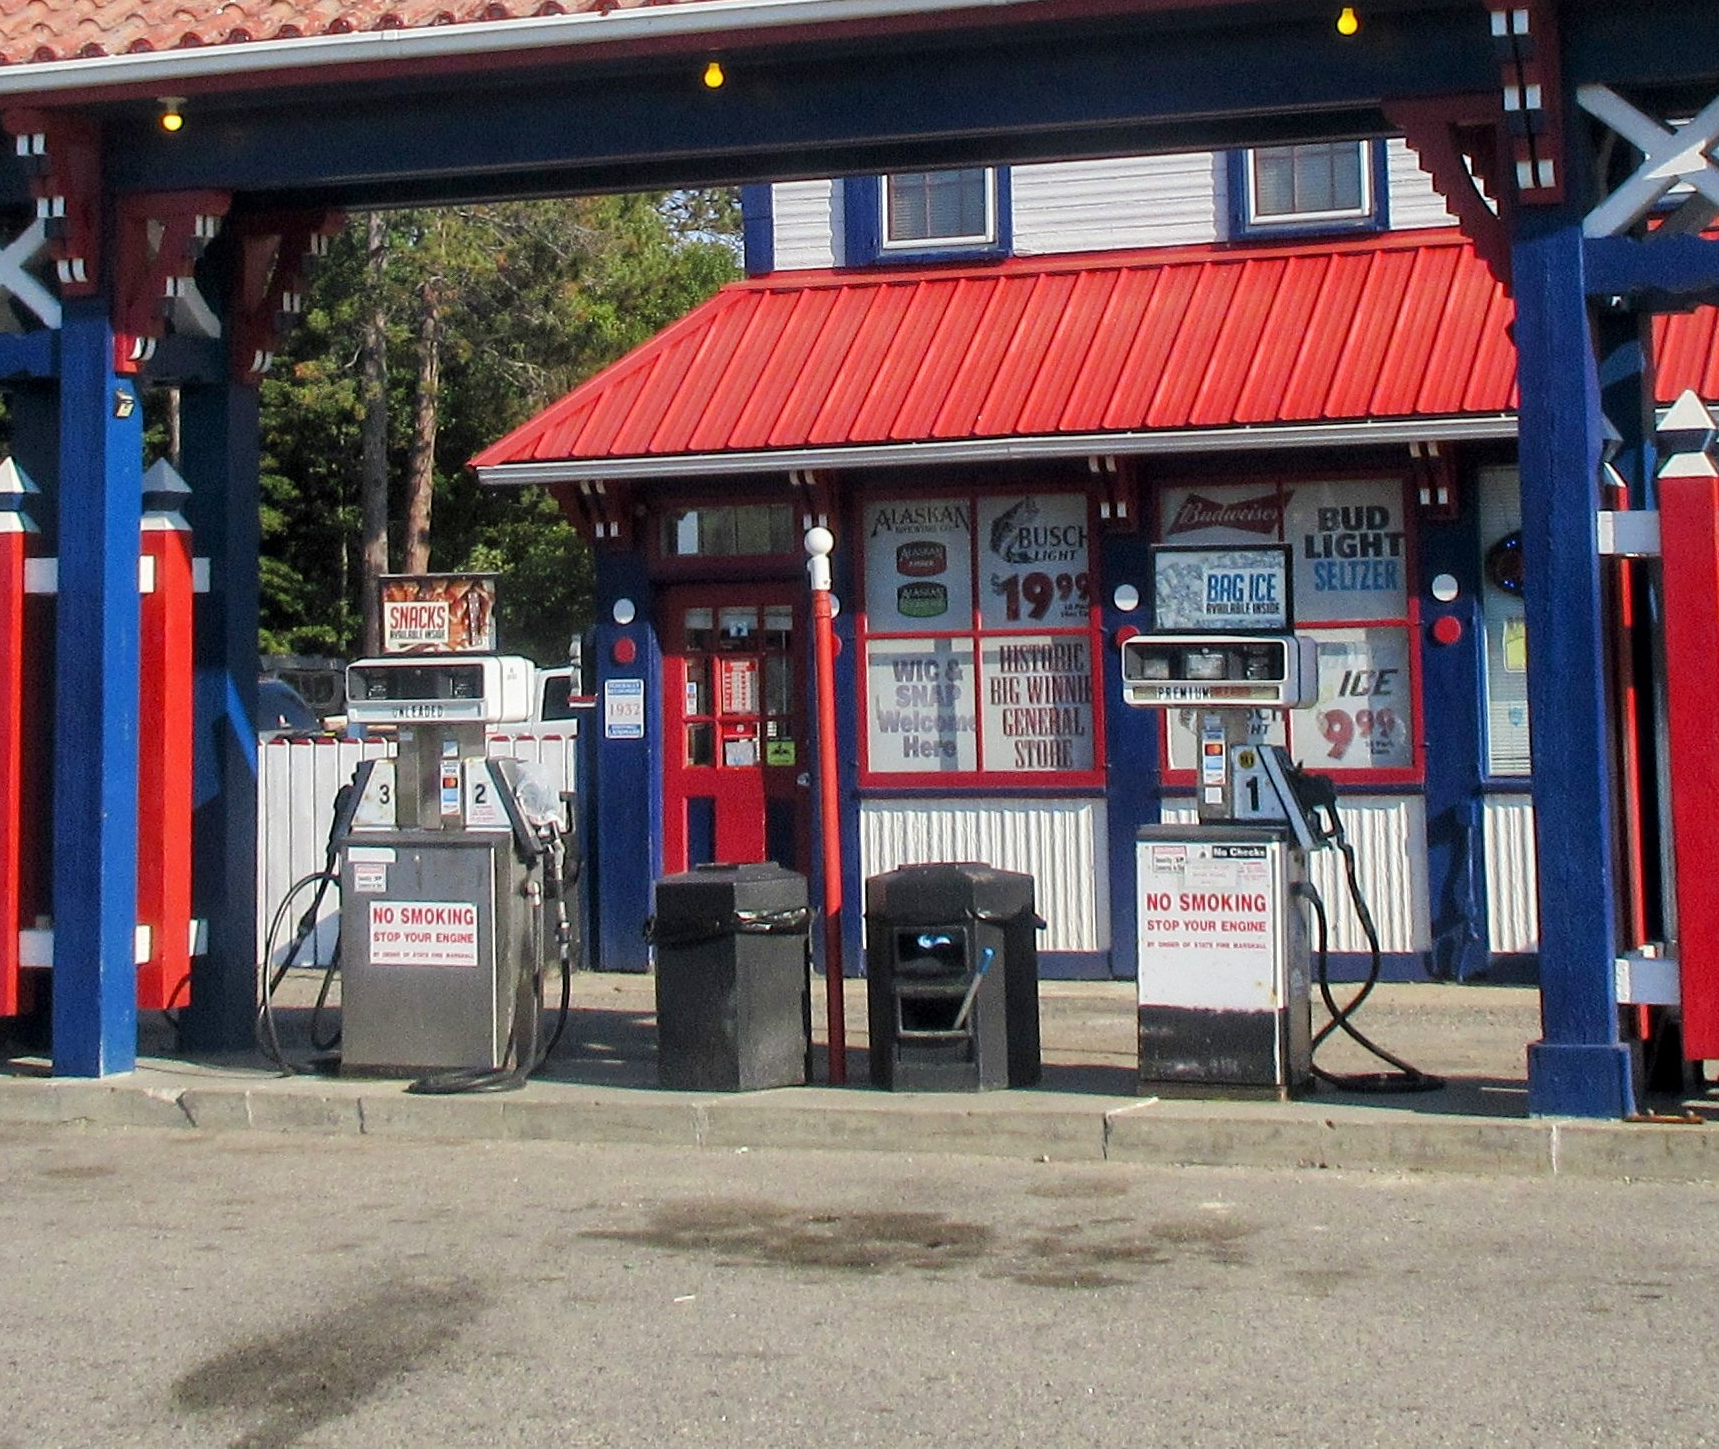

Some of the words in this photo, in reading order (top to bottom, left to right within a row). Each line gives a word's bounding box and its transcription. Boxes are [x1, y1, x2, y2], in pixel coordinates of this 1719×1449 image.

[871, 505, 970, 538] ALASKAN
[1180, 502, 1279, 526] Budweiser
[1318, 506, 1390, 531] BUD
[1035, 550, 1077, 562] LIGHT
[1304, 532, 1405, 559] LIGHT
[1314, 559, 1398, 591] SELTZER
[1207, 574, 1245, 602] BAG
[1249, 574, 1277, 602] ICE
[390, 606, 446, 630] SNACKS
[1206, 603, 1250, 614] AVAILABLE
[1252, 603, 1280, 614] INSIDE
[892, 659, 940, 682] WIC
[945, 658, 963, 681] &
[1000, 643, 1084, 673] HISTORIC
[990, 676, 1020, 705] BIG
[1158, 686, 1210, 700] PREMIUM
[1338, 668, 1399, 697] ICE
[896, 684, 962, 707] SNAP
[393, 705, 444, 718] UNLEADED
[609, 702, 641, 716] 1932
[876, 707, 975, 733] Welcome
[1002, 707, 1085, 737] GENERAL
[903, 735, 957, 758] Here
[1014, 738, 1074, 768] STORE
[379, 784, 390, 805] 3
[475, 784, 486, 804] 2
[1246, 776, 1259, 812] 1
[1213, 847, 1228, 857] No
[1229, 847, 1265, 857] Checks
[1146, 893, 1172, 911] NO
[1180, 893, 1266, 912] SMOKING
[373, 907, 394, 924] NO
[400, 907, 475, 925] SMOKING
[1147, 920, 1180, 932] STOP
[1184, 920, 1216, 932] YOUR
[1221, 921, 1267, 933] ENGINE
[373, 932, 401, 942] STOP
[404, 932, 432, 942] YOUR
[436, 933, 474, 943] ENGINE
